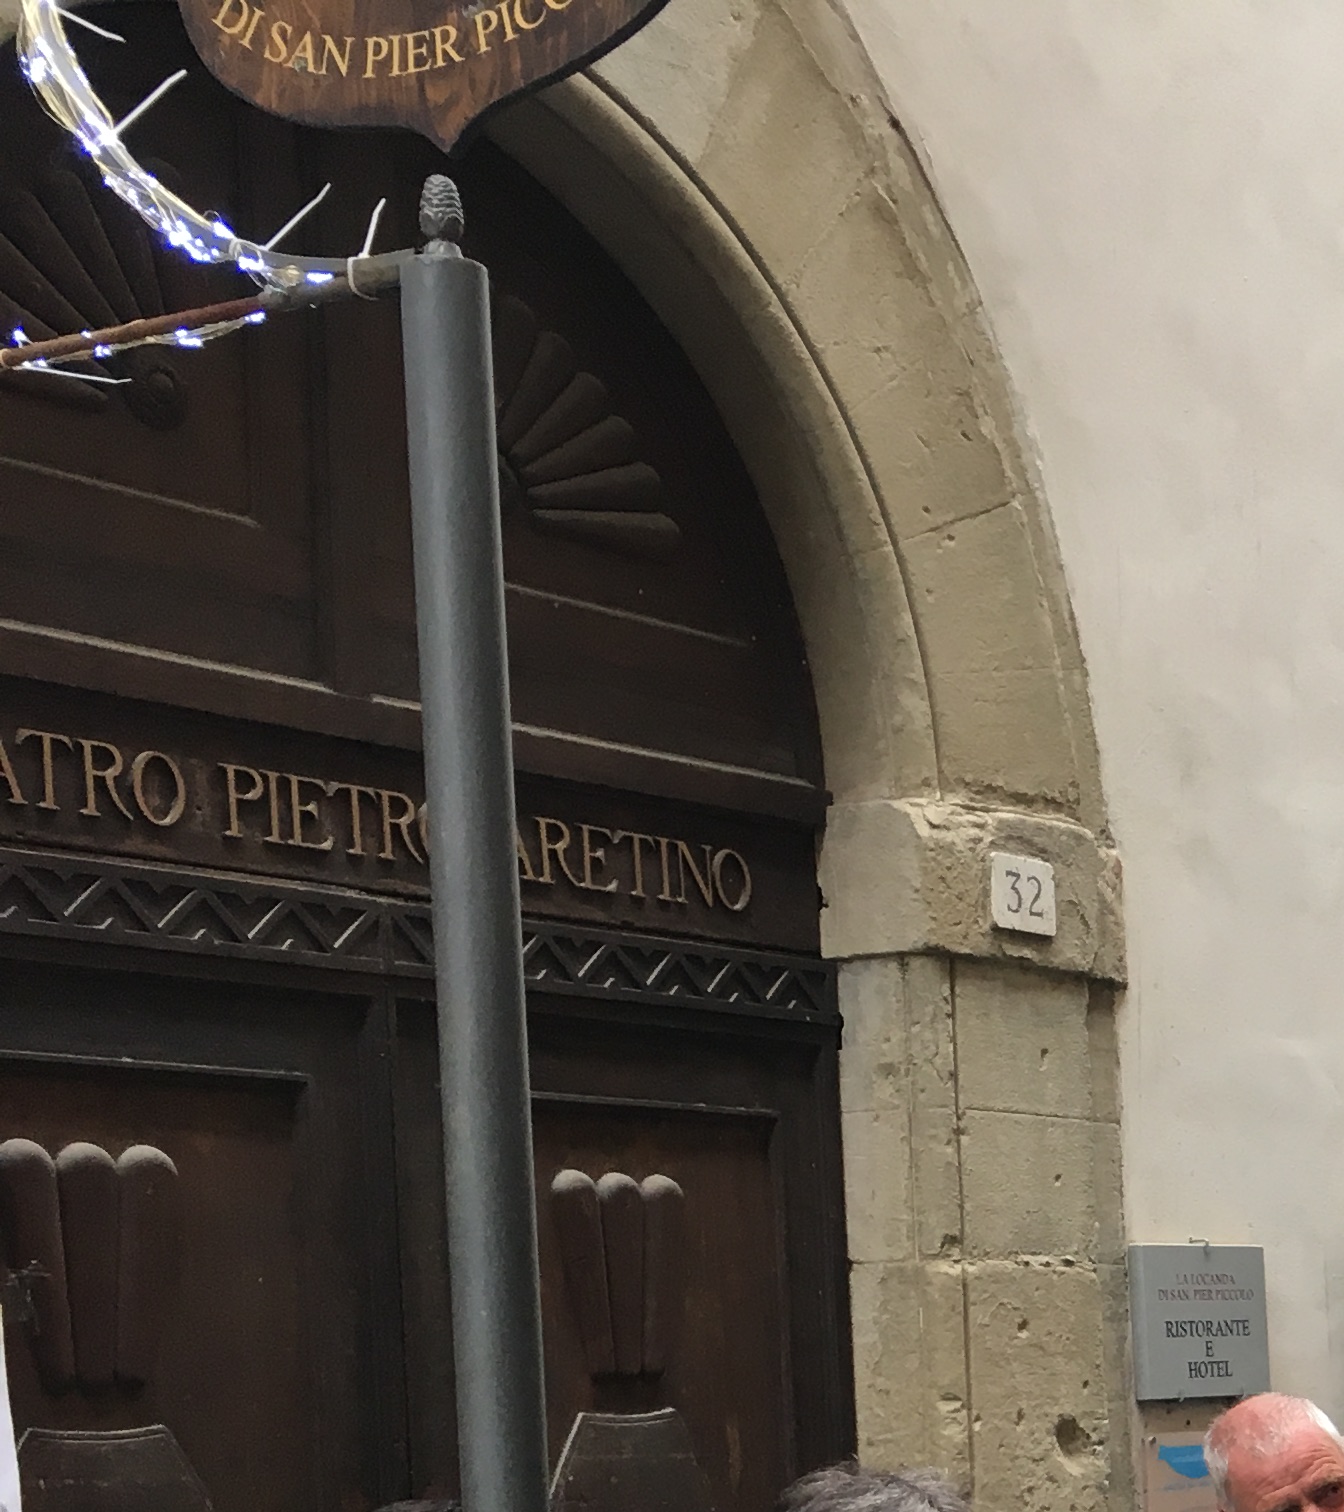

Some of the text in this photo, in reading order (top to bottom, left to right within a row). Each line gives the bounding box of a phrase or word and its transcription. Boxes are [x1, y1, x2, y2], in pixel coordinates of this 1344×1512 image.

[210, 0, 574, 79] DI SAN PIER PIC
[216, 762, 428, 865] PIETR
[1005, 869, 1045, 919] 32
[1175, 1273, 1236, 1286] LA LOCANDA
[1164, 1319, 1251, 1338] RISTORANTE
[1205, 1340, 1215, 1358] E
[1187, 1360, 1234, 1379] HOTEL
